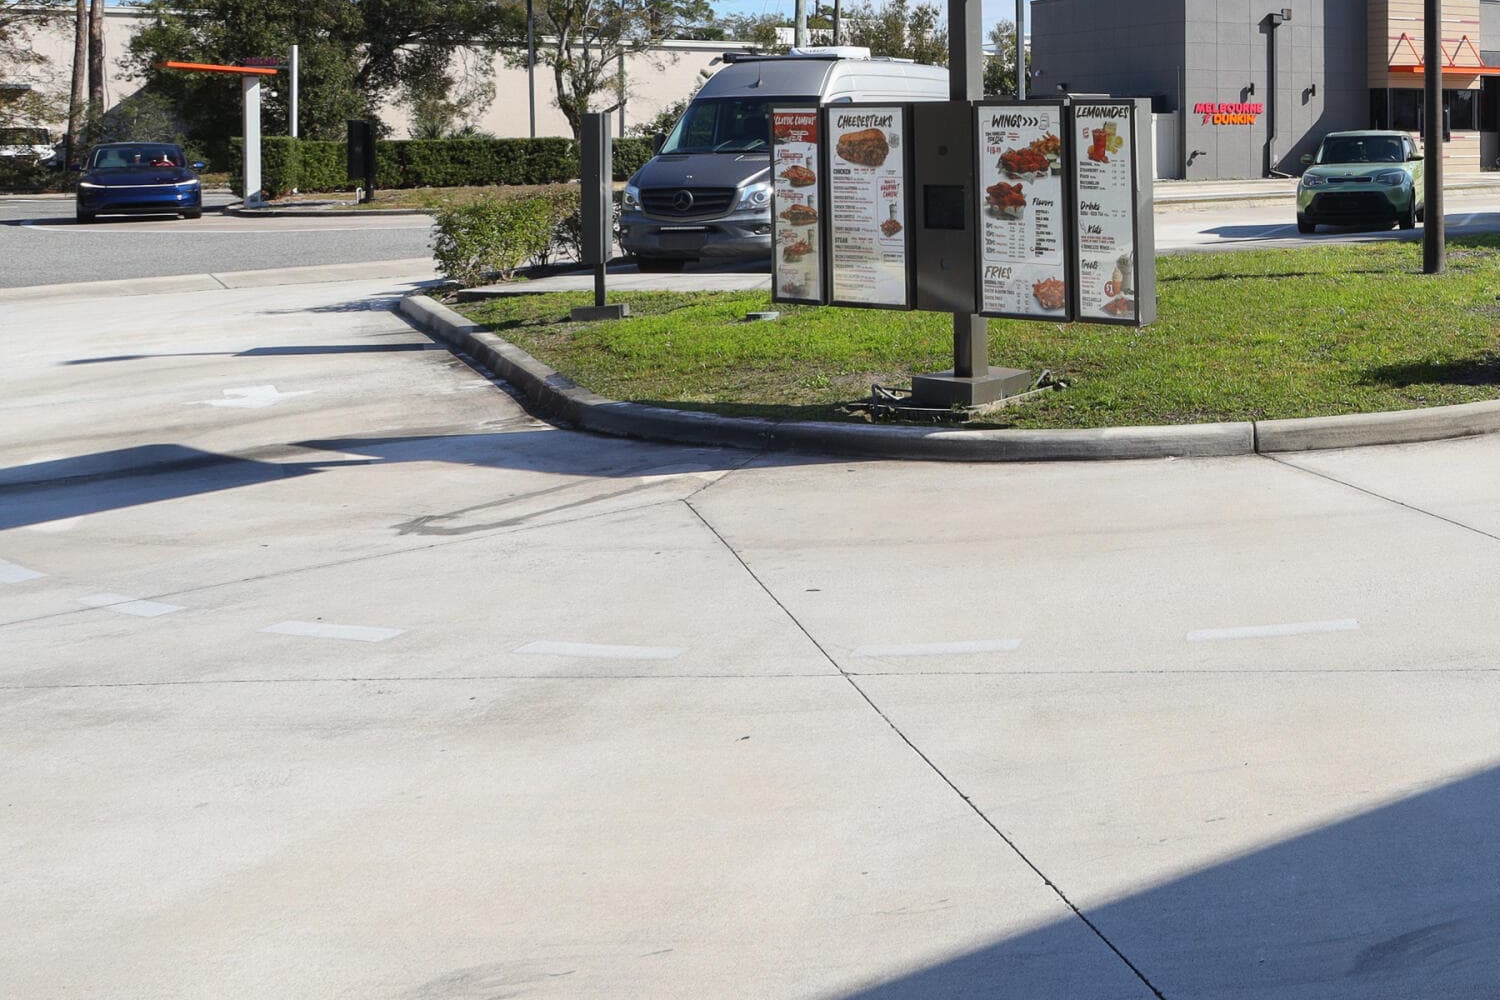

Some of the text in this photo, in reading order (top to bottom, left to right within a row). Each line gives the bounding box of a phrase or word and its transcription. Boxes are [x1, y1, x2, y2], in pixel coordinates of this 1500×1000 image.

[1076, 106, 1129, 119] LEMONADES
[1195, 103, 1263, 114] MELBOURNE
[837, 114, 893, 129] CHEESESTEAKS
[991, 113, 1022, 129] WINGS
[1032, 197, 1054, 207] Flavors
[1080, 200, 1101, 211] Drinks
[1087, 224, 1102, 235] Kids
[985, 265, 1012, 280] FRIES
